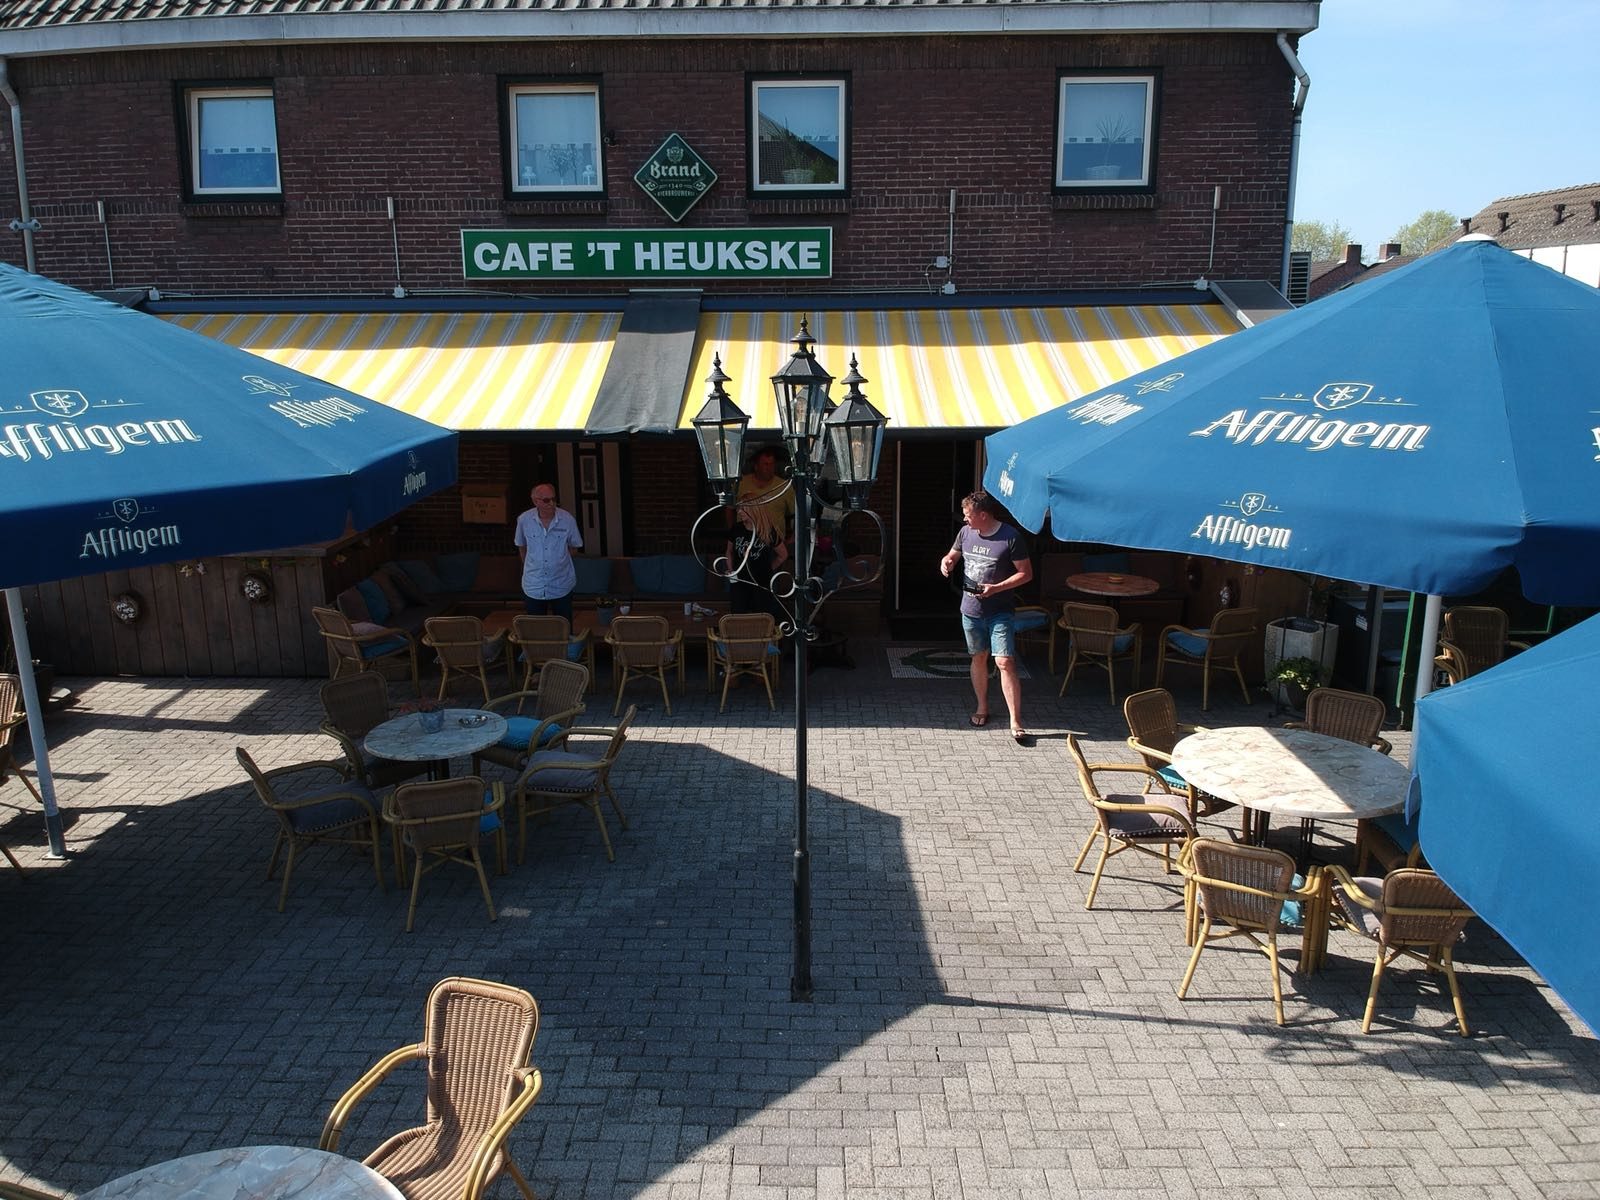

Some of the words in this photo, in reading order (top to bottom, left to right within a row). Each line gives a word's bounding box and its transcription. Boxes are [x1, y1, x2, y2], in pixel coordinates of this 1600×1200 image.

[650, 160, 701, 179] Brand
[473, 242, 575, 271] CAFE
[587, 242, 621, 271] 'T
[634, 241, 821, 271] HEUKSKE
[1188, 408, 1432, 452] Affligem
[79, 524, 181, 558] Affligem
[1190, 514, 1293, 551] Affligem
